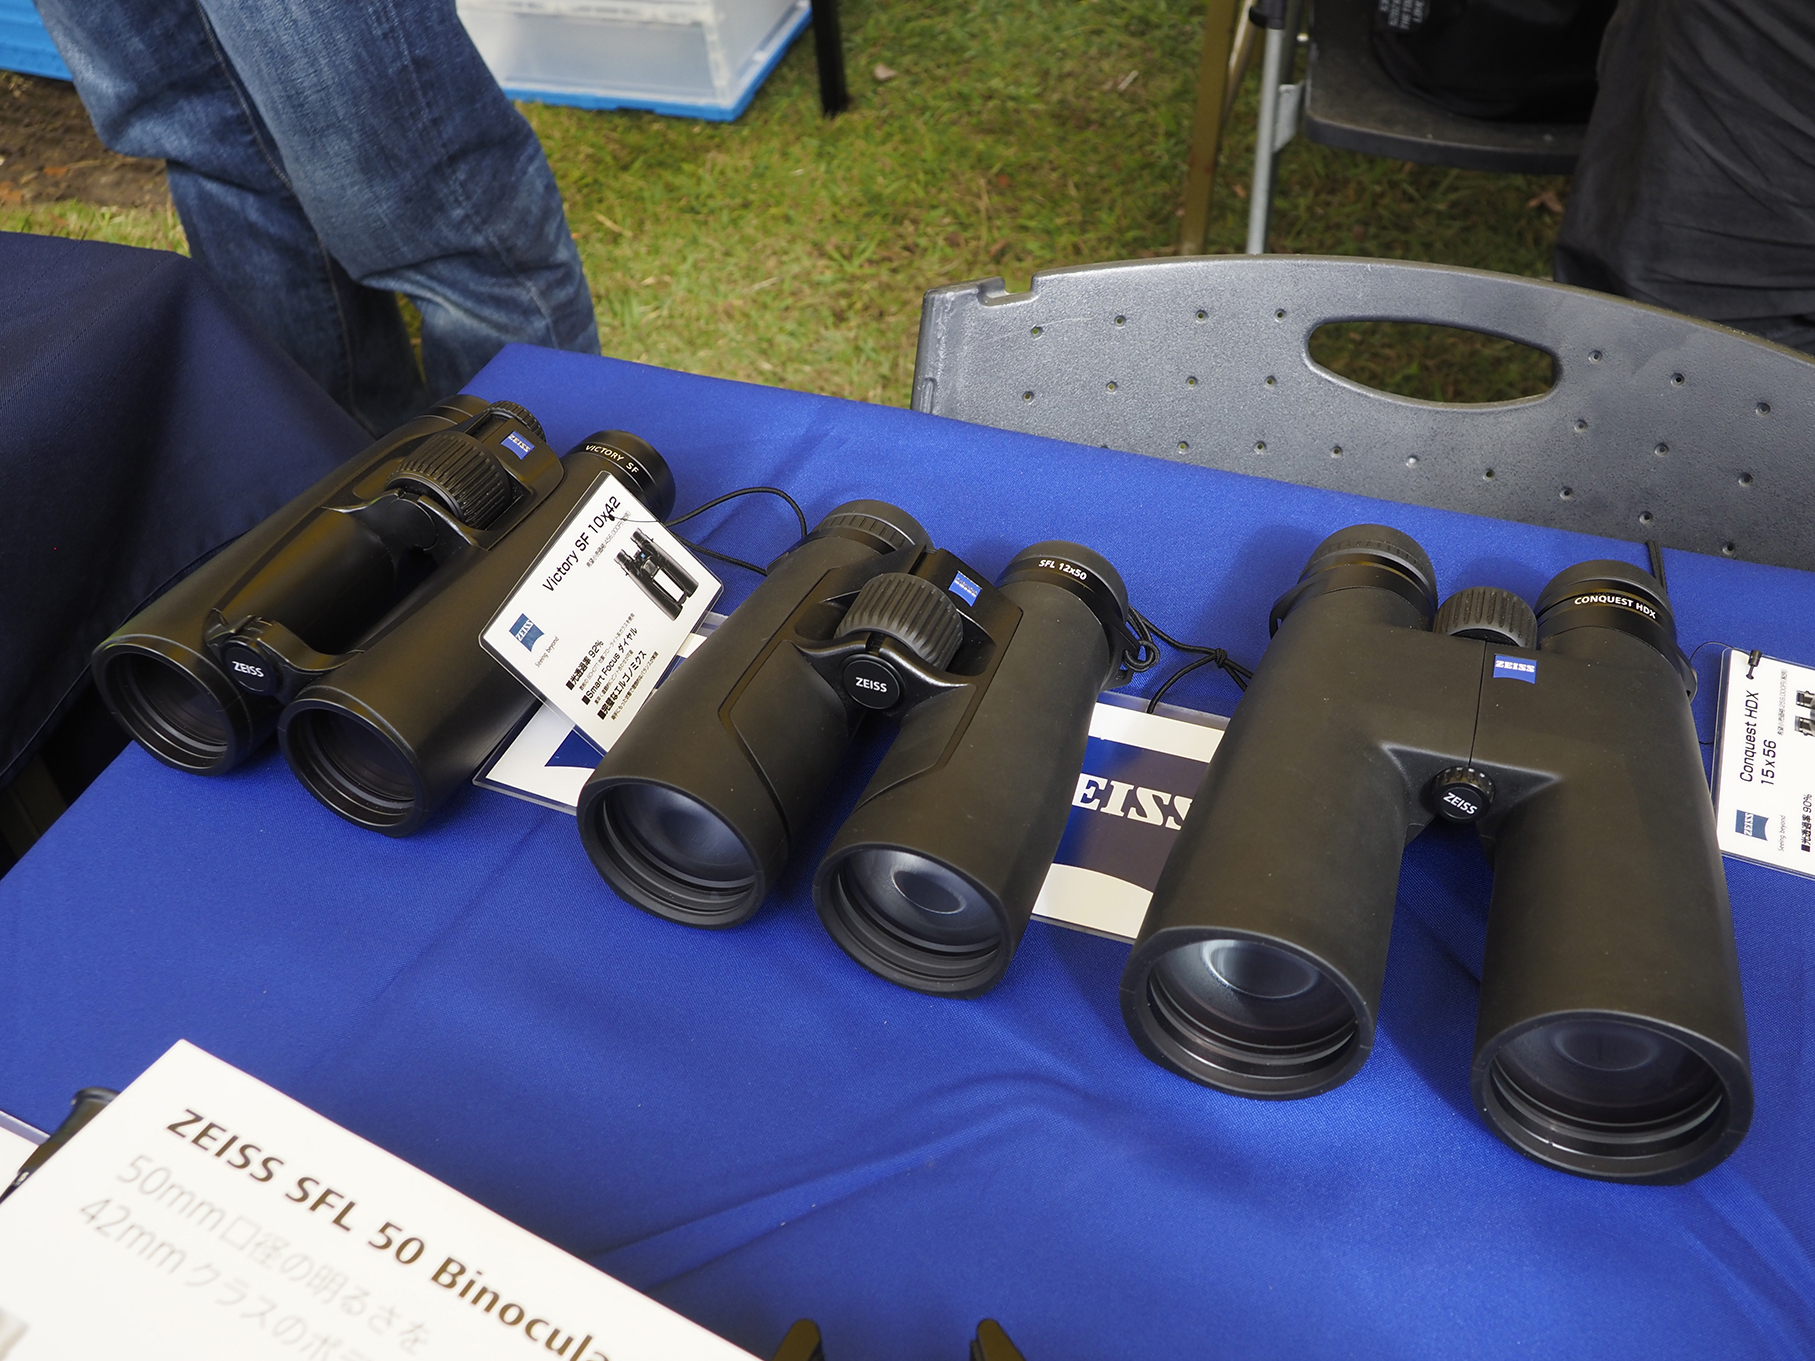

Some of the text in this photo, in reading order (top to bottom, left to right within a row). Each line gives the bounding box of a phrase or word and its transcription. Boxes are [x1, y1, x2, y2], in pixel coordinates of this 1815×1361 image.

[508, 434, 530, 452] ZEISS
[586, 444, 640, 474] VICTORY SF
[542, 495, 621, 592] Victory SF 10x42
[1038, 559, 1088, 581] SFL 12x50
[1574, 595, 1657, 619] CONQUEST HDX
[515, 619, 534, 642] ZEISS
[588, 640, 604, 659] 92%
[232, 661, 264, 677] ZEISS
[586, 627, 638, 699] Smart Focus ダイヤル
[1495, 661, 1535, 673] ZEISS
[855, 677, 887, 693] ZEISS
[1740, 689, 1759, 783] Conquest HDX
[1443, 793, 1478, 815] ZEISS
[1802, 794, 1812, 813] 90%
[1744, 812, 1753, 837] ZEISS
[167, 1109, 284, 1183] ZEISS
[285, 1176, 356, 1232] SFL
[368, 1222, 426, 1265] 50
[79, 1199, 188, 1275] 42mm
